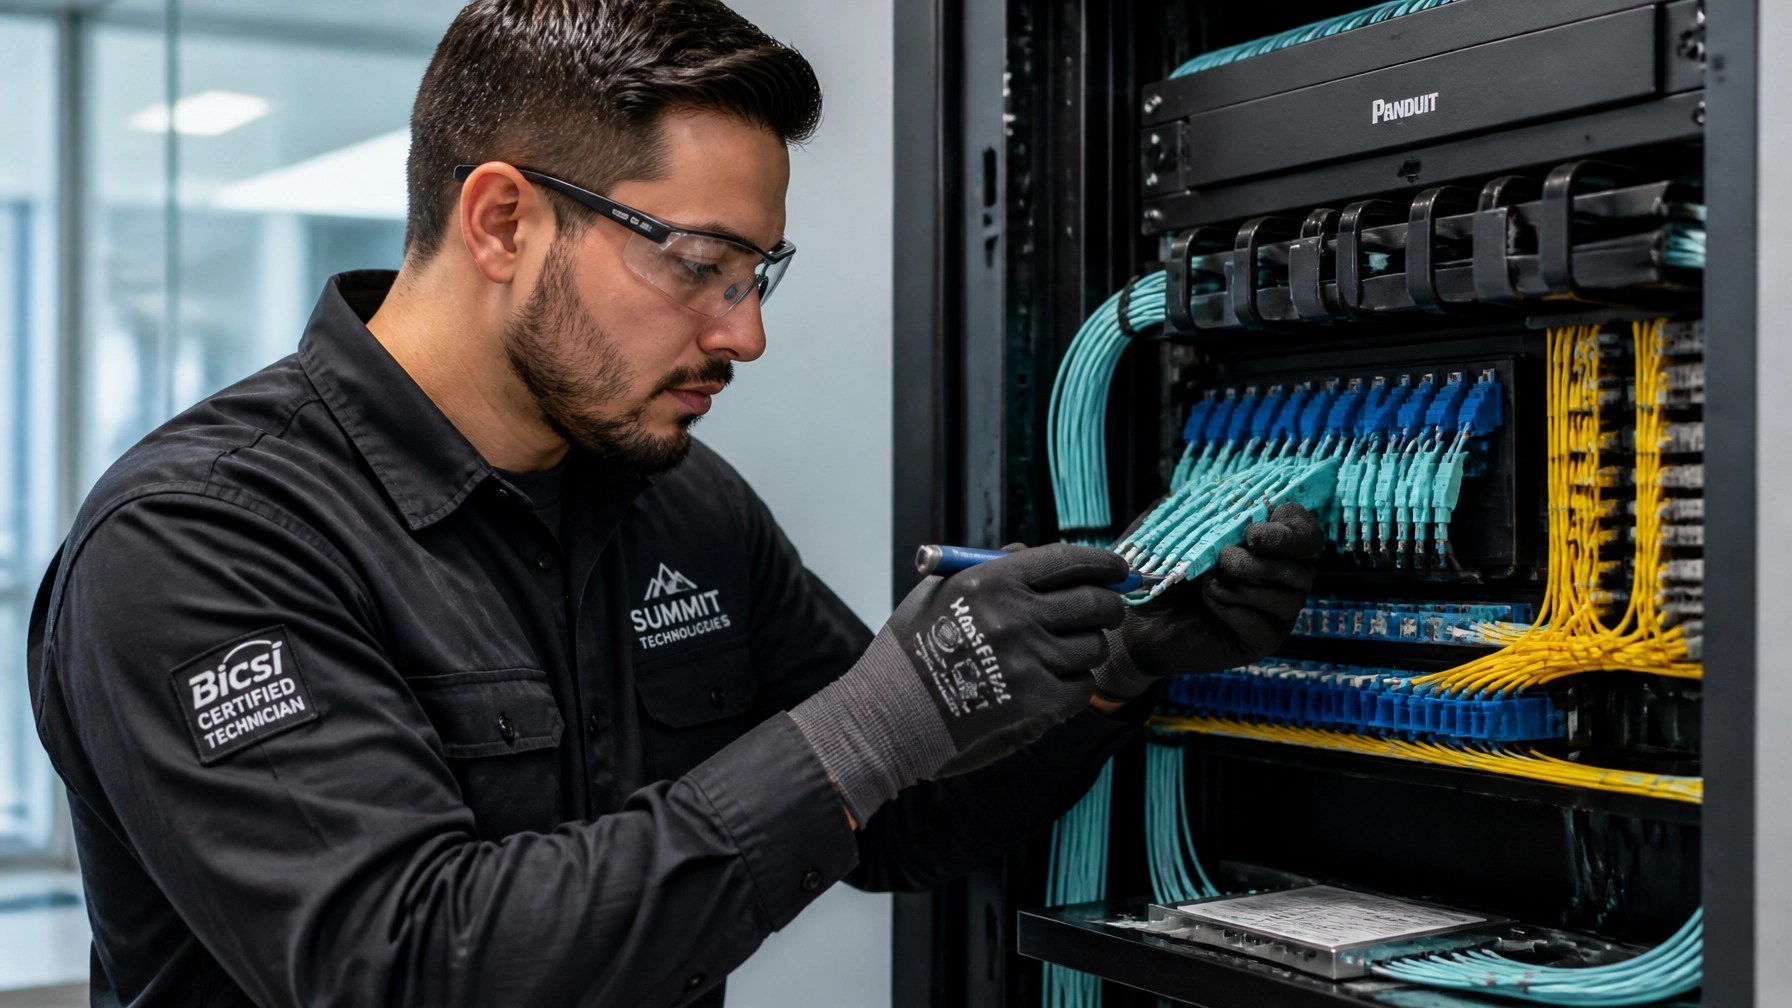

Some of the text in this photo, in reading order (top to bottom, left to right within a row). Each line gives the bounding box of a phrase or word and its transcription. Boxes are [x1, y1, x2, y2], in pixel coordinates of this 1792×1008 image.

[1372, 92, 1439, 124] PANDUIT
[630, 589, 720, 632] SUMMIT
[197, 677, 296, 730] CERTIFIED
[204, 695, 306, 749] TECHNICIAN
